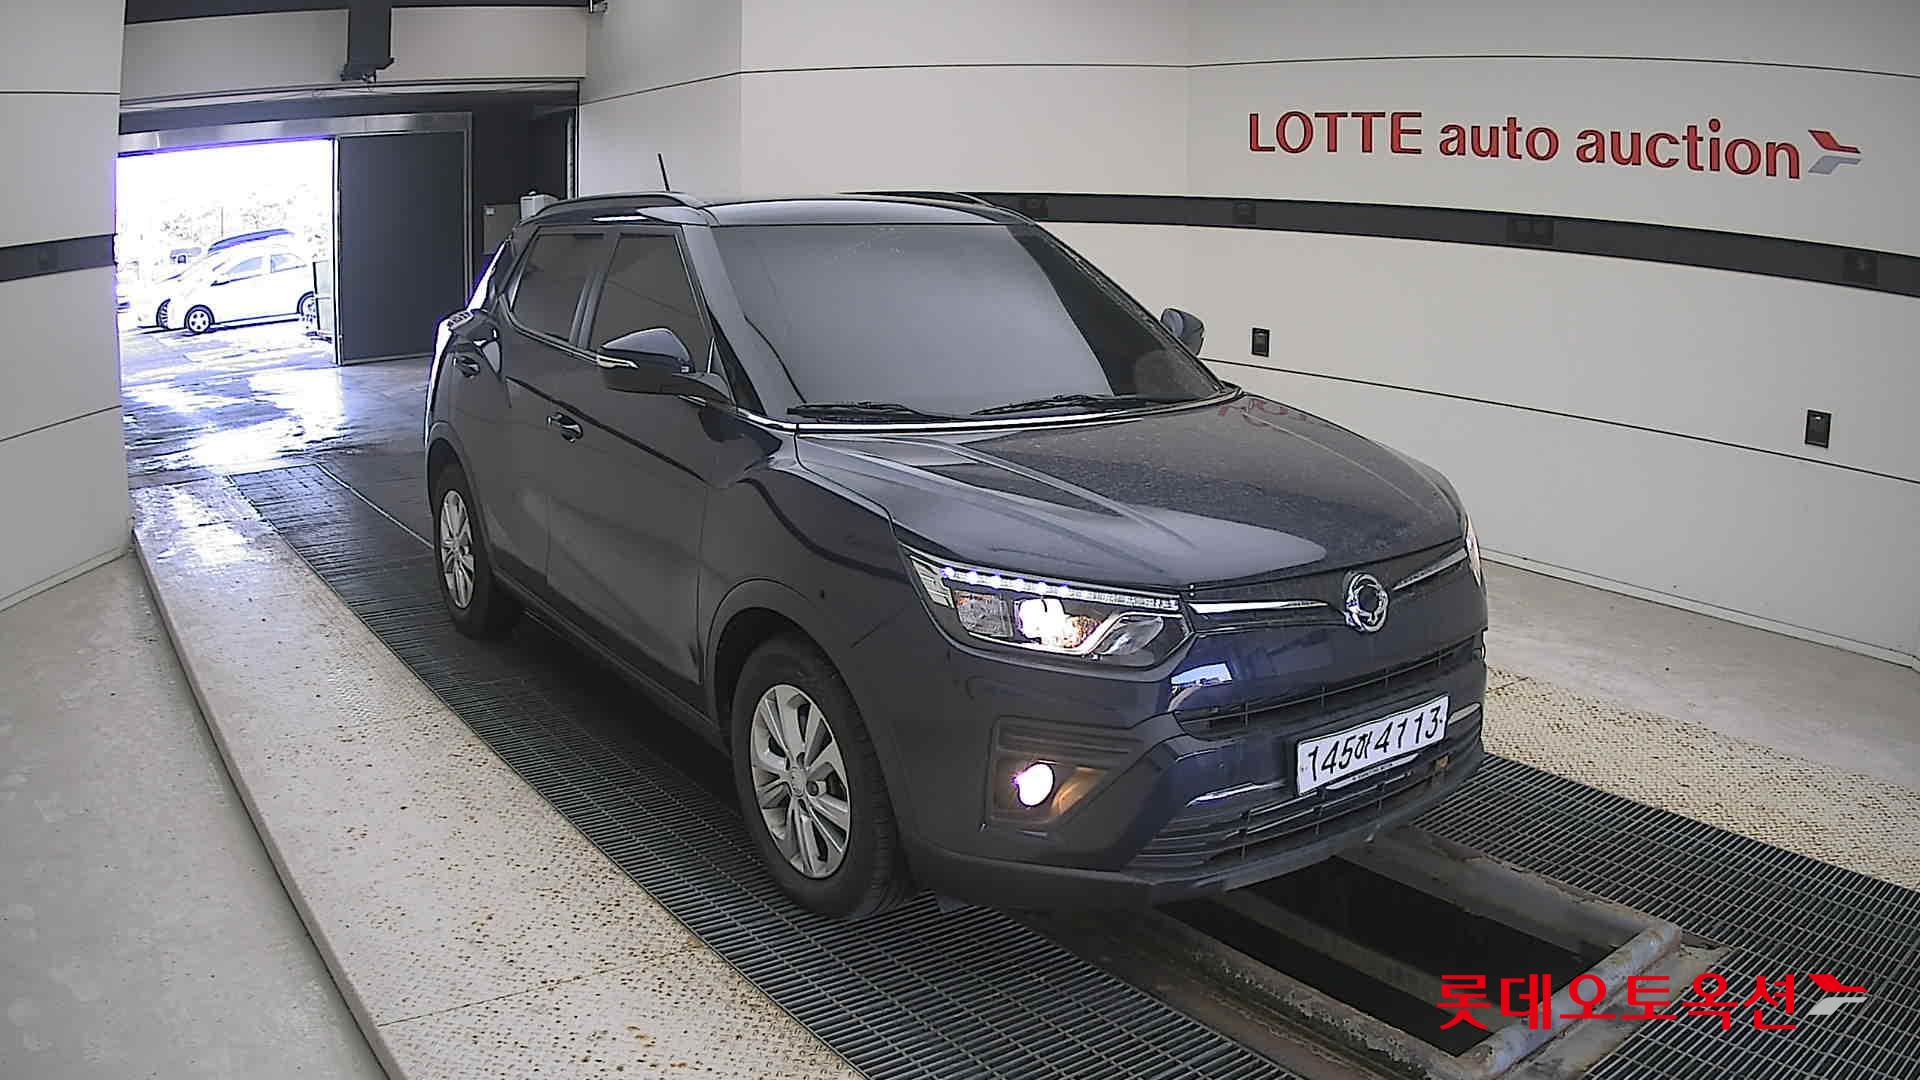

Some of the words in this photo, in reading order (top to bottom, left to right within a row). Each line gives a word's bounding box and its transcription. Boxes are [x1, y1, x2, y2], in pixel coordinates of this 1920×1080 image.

[1249, 111, 1423, 155] LOTTE
[1439, 116, 1560, 162] auto
[1575, 117, 1801, 180] auction
